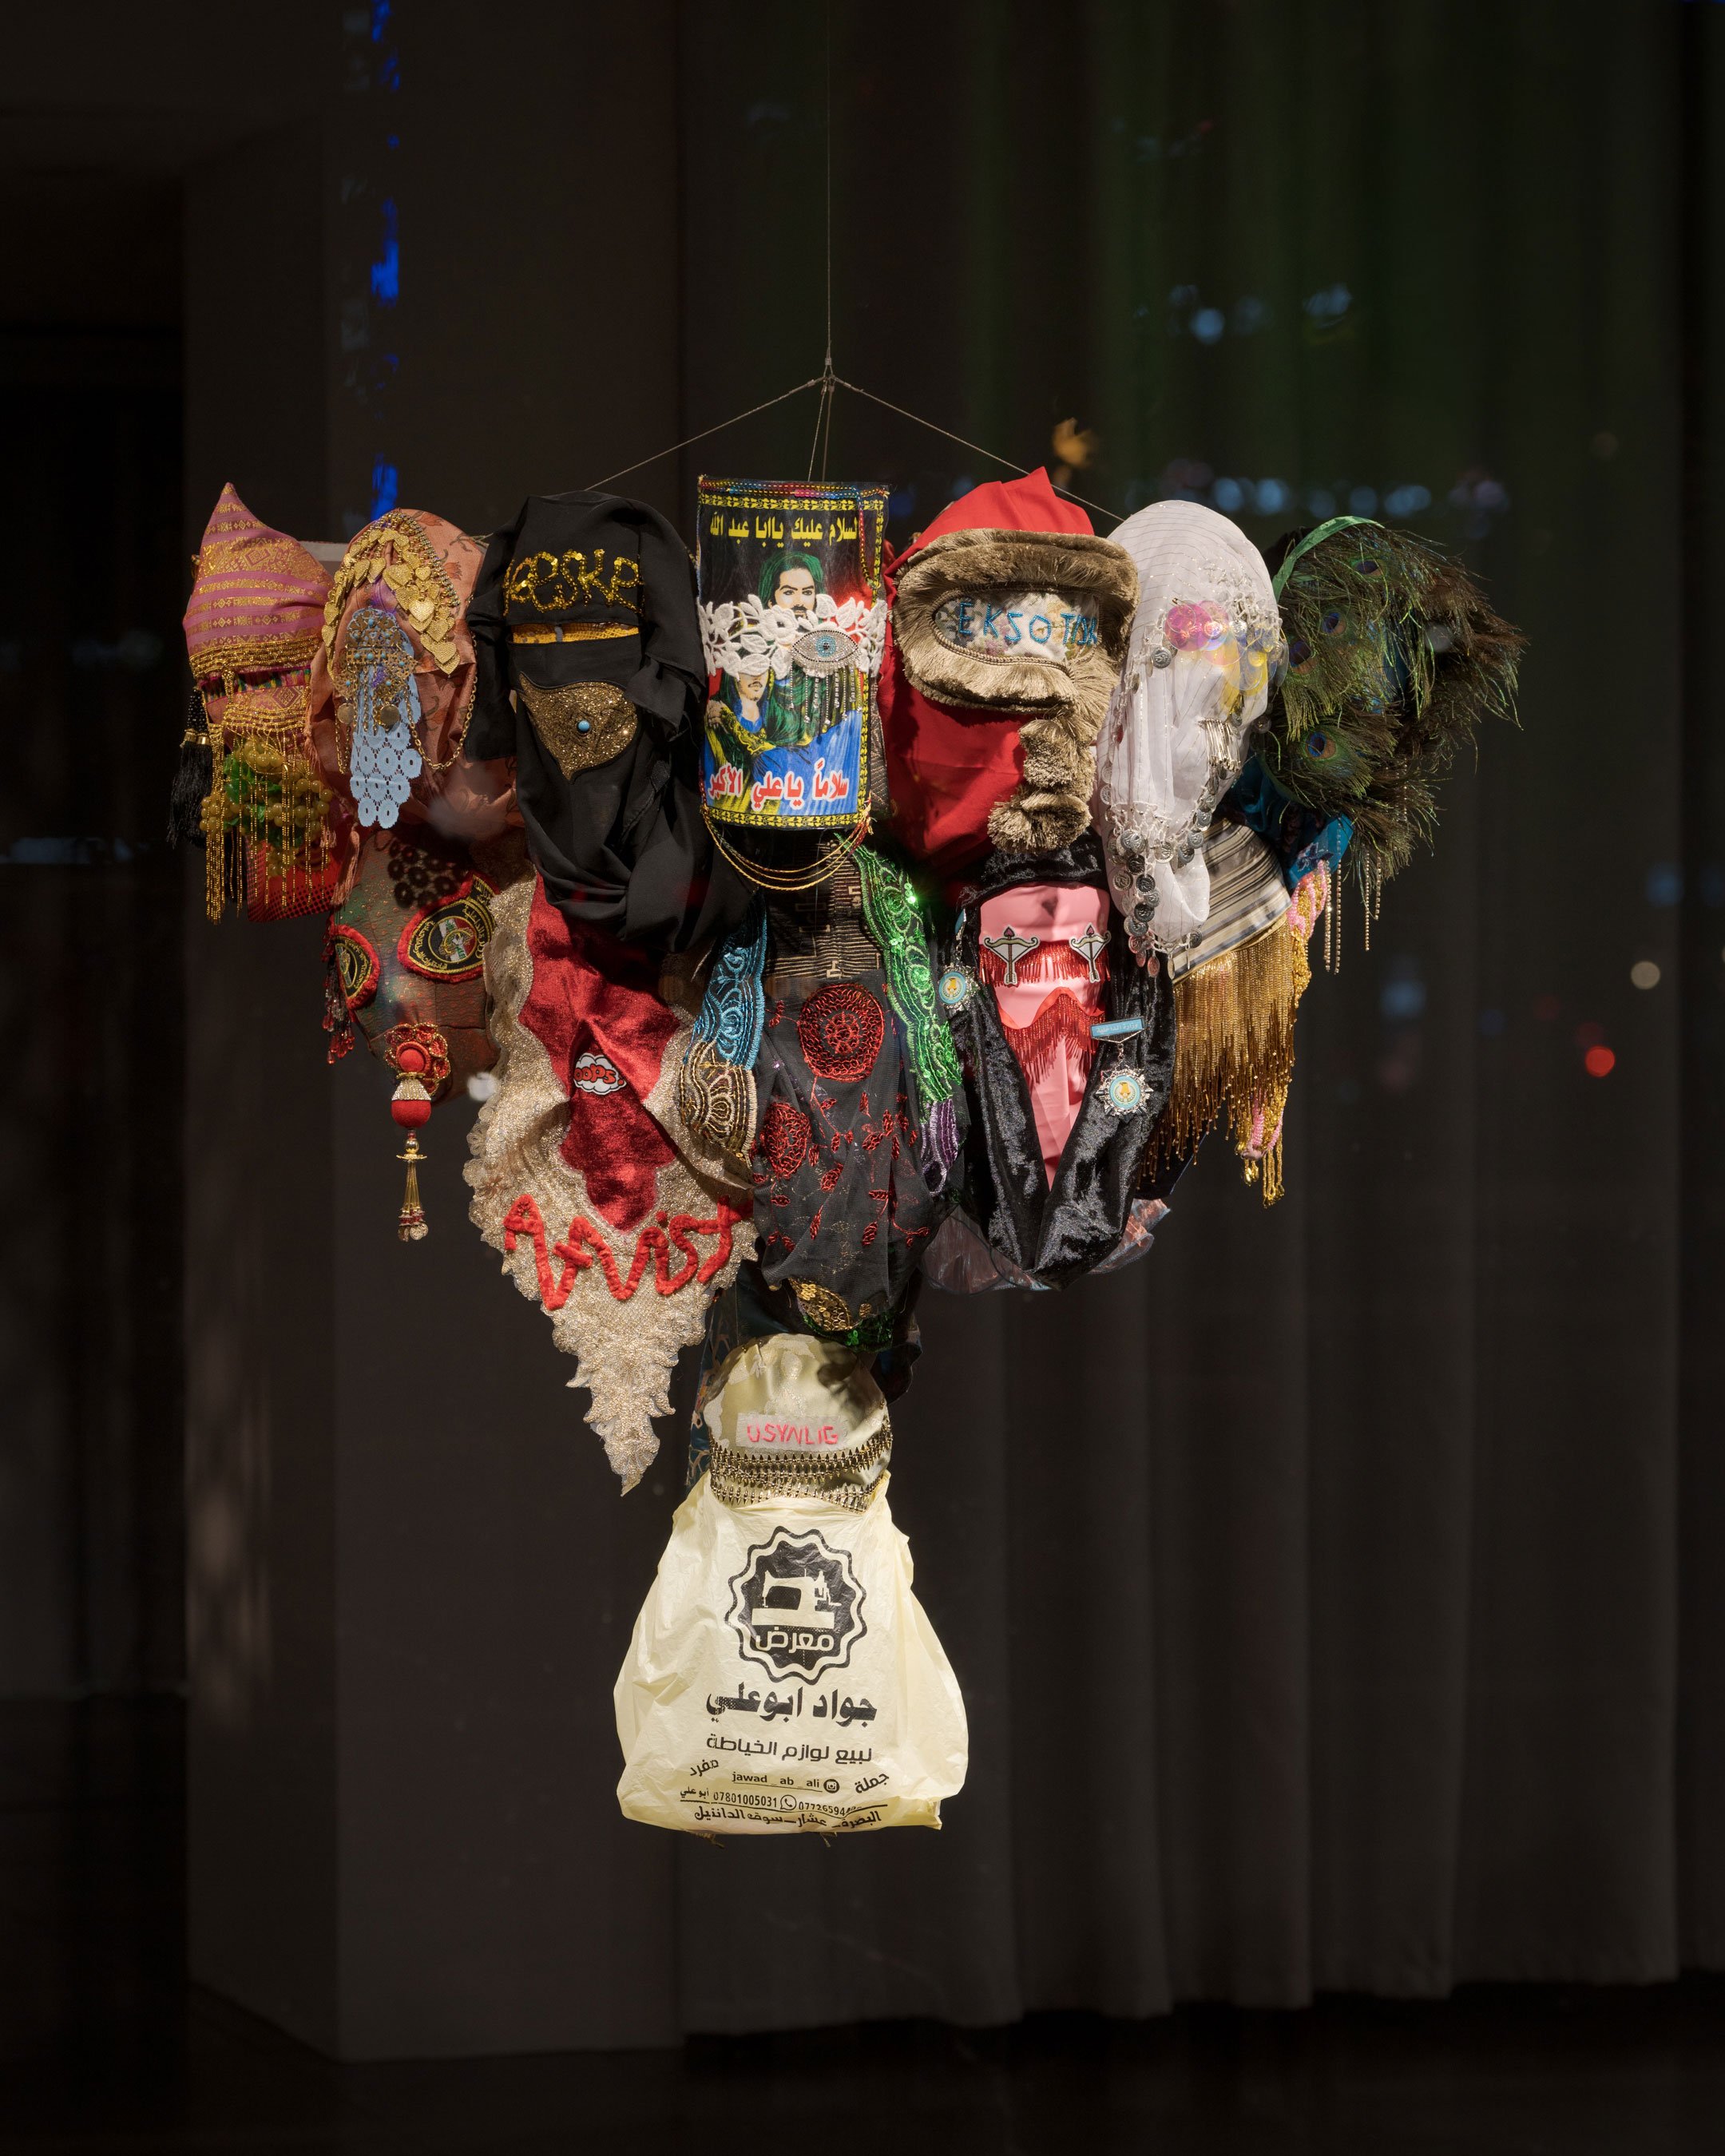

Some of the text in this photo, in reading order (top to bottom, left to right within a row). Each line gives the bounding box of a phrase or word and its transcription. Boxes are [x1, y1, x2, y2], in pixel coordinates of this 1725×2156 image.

[710, 511, 724, 536] الله
[728, 517, 749, 544] عبد
[791, 517, 823, 548] عليك
[829, 517, 859, 546] لسلام
[747, 1423, 839, 1445] USYNLIG
[755, 1626, 835, 1654] معرض
[812, 1688, 878, 1728] جواد
[706, 1734, 872, 1765] لبيع لوازم الخياطة
[690, 1759, 719, 1778] مفرد
[855, 1773, 890, 1793] جملة
[713, 1792, 777, 1808] 07801005031
